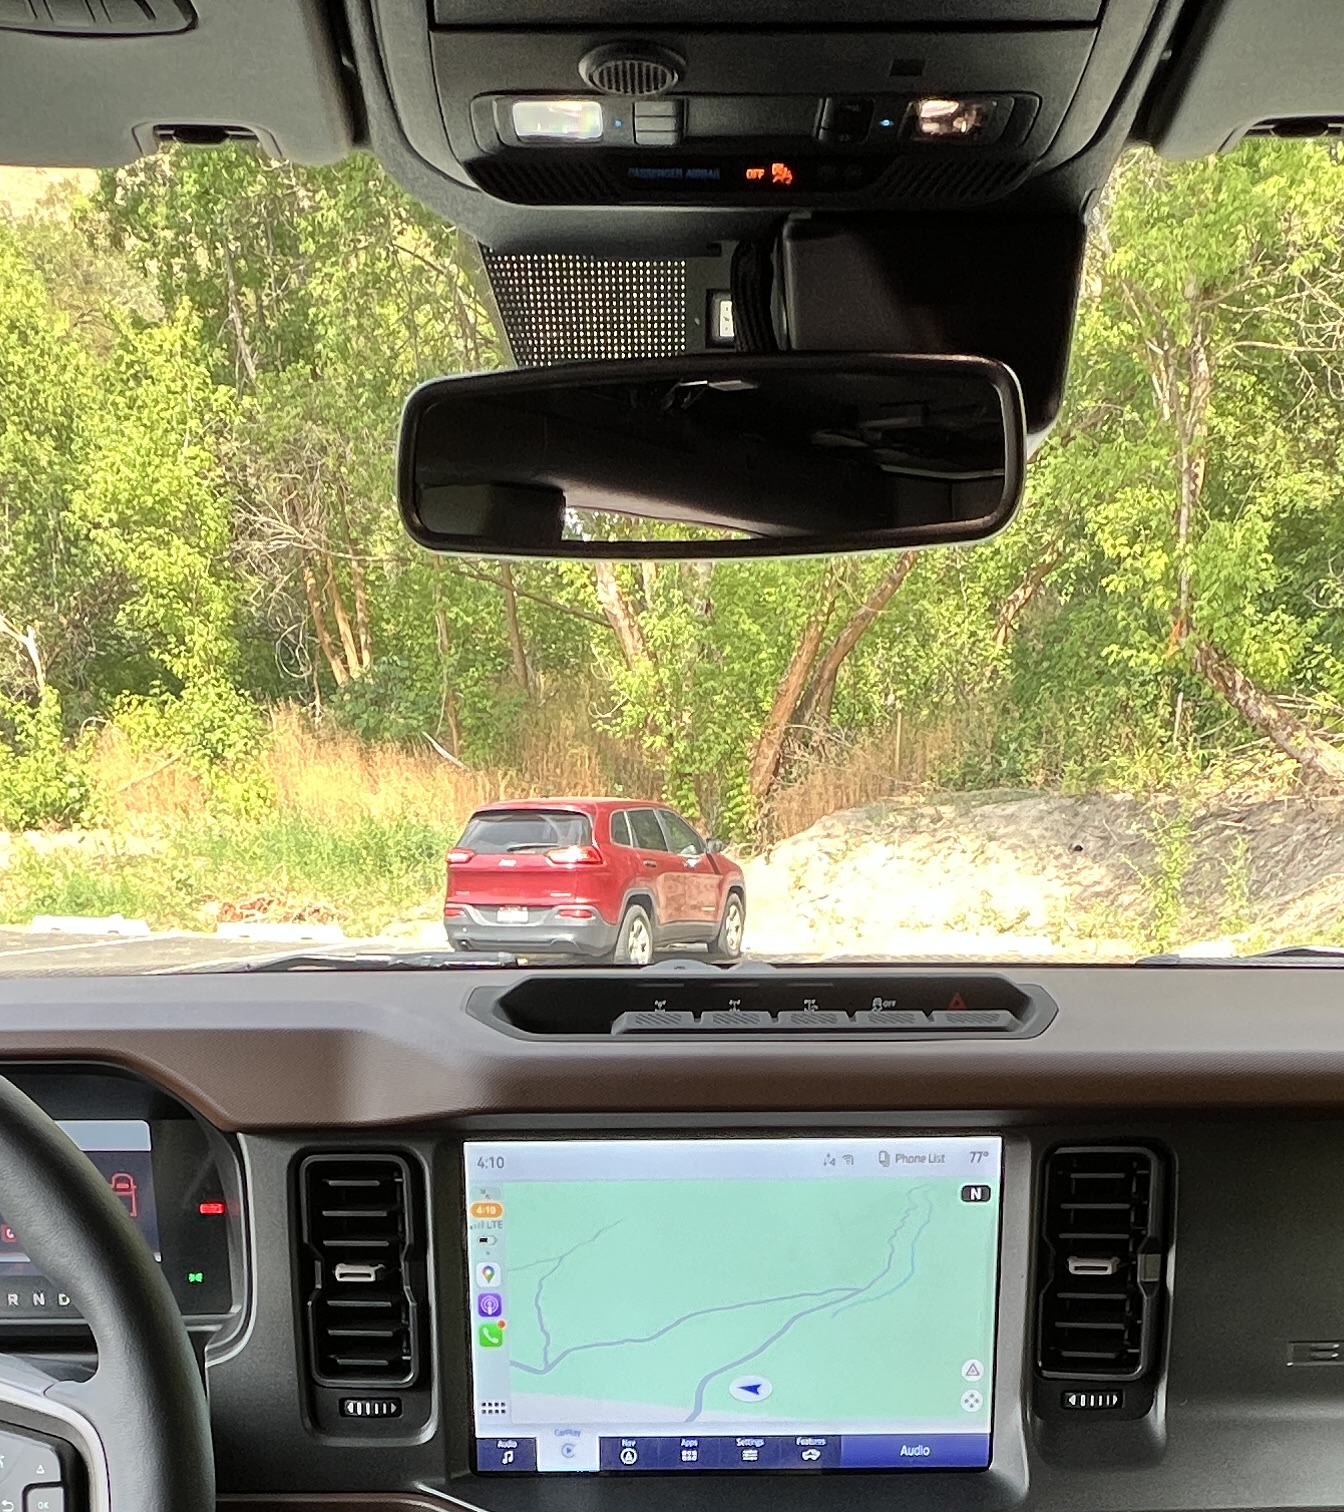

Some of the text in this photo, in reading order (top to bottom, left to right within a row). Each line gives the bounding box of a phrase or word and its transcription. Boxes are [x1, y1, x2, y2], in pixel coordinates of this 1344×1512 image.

[746, 168, 765, 180] OFF
[476, 1156, 505, 1170] 4:10
[895, 1153, 946, 1164] Phone List
[969, 1151, 989, 1164] 77°
[969, 1187, 982, 1200] N
[476, 1205, 497, 1215] 4:10
[487, 1220, 504, 1230] LTE
[7, 1292, 20, 1305] R
[32, 1292, 47, 1306] N
[58, 1293, 71, 1306] D
[497, 1439, 518, 1449] Audio
[621, 1438, 637, 1448] Nav
[680, 1437, 698, 1448] Apps
[736, 1437, 765, 1448] Settings
[795, 1436, 826, 1446] Features
[900, 1445, 931, 1458] Audio
[37, 1501, 50, 1510] OK
